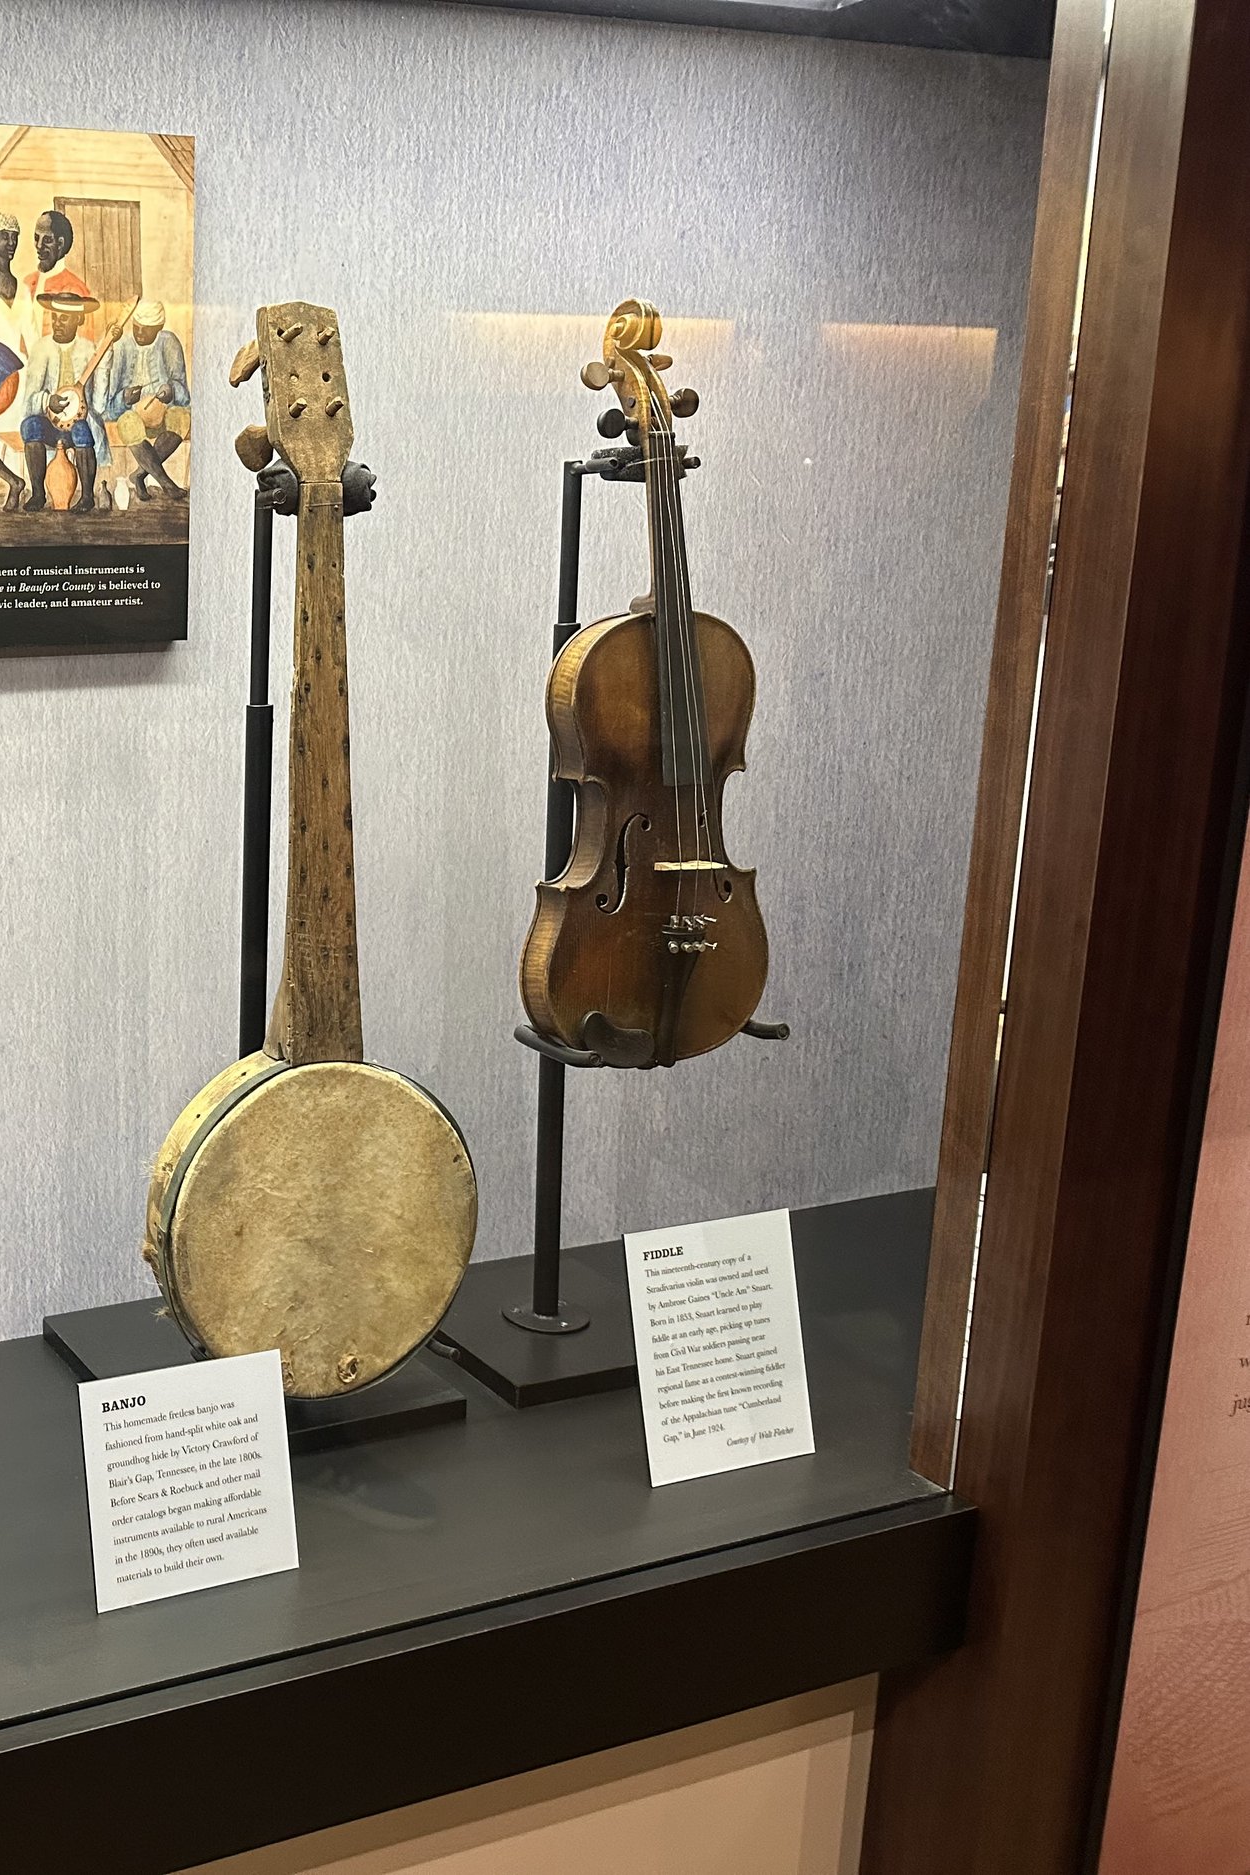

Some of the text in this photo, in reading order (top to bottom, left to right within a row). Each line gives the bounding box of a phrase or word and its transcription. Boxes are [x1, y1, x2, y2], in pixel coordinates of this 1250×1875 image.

[19, 565, 31, 576] of
[32, 565, 72, 575] musical
[74, 565, 134, 574] instruments
[136, 563, 144, 573] is
[6, 582, 16, 592] in
[18, 581, 59, 593] Beaufort
[61, 581, 96, 592] County
[97, 580, 106, 590] is
[108, 579, 148, 590] believed
[150, 581, 160, 589] to
[14, 598, 47, 609] leader,
[49, 597, 68, 607] and
[70, 598, 112, 606] amateur
[114, 595, 143, 605] artist.
[642, 1245, 684, 1261] FIDDLE
[101, 1395, 146, 1413] BANJO
[102, 1401, 235, 1432] This homemade fretless banjo was
[104, 1412, 258, 1451] fashioned from hand-split white oak and
[108, 1475, 133, 1488] Blair's
[134, 1473, 154, 1484] Gap,
[155, 1465, 197, 1479] Tennessee,
[198, 1461, 207, 1471] in
[208, 1458, 221, 1469] the
[222, 1456, 236, 1466] late
[114, 1525, 258, 1565] in the 1890s, they often used available
[116, 1554, 224, 1583] materials to build their own.
